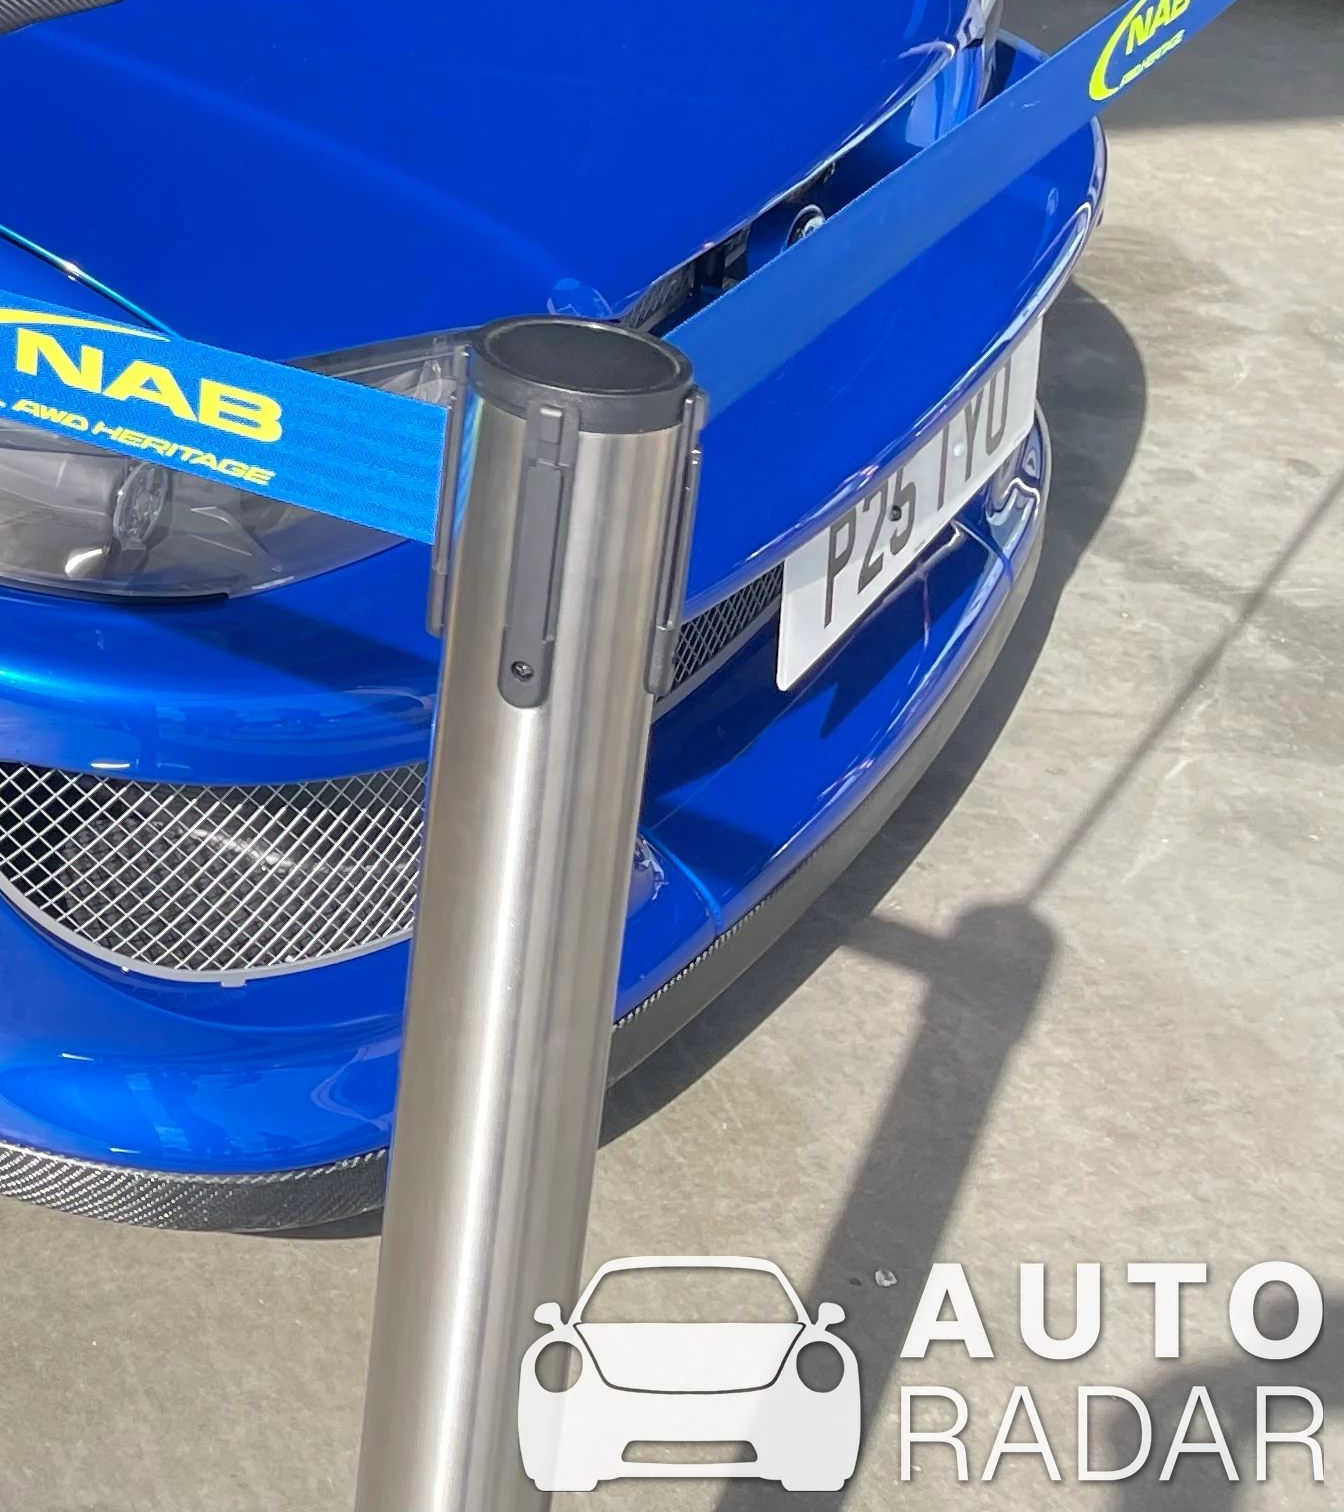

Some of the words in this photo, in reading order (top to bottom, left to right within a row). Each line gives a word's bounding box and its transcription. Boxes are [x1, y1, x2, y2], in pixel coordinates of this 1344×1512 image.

[11, 398, 88, 434] AWD
[90, 421, 276, 487] HERITAGE
[15, 327, 283, 443] NAB
[824, 465, 917, 629] P25
